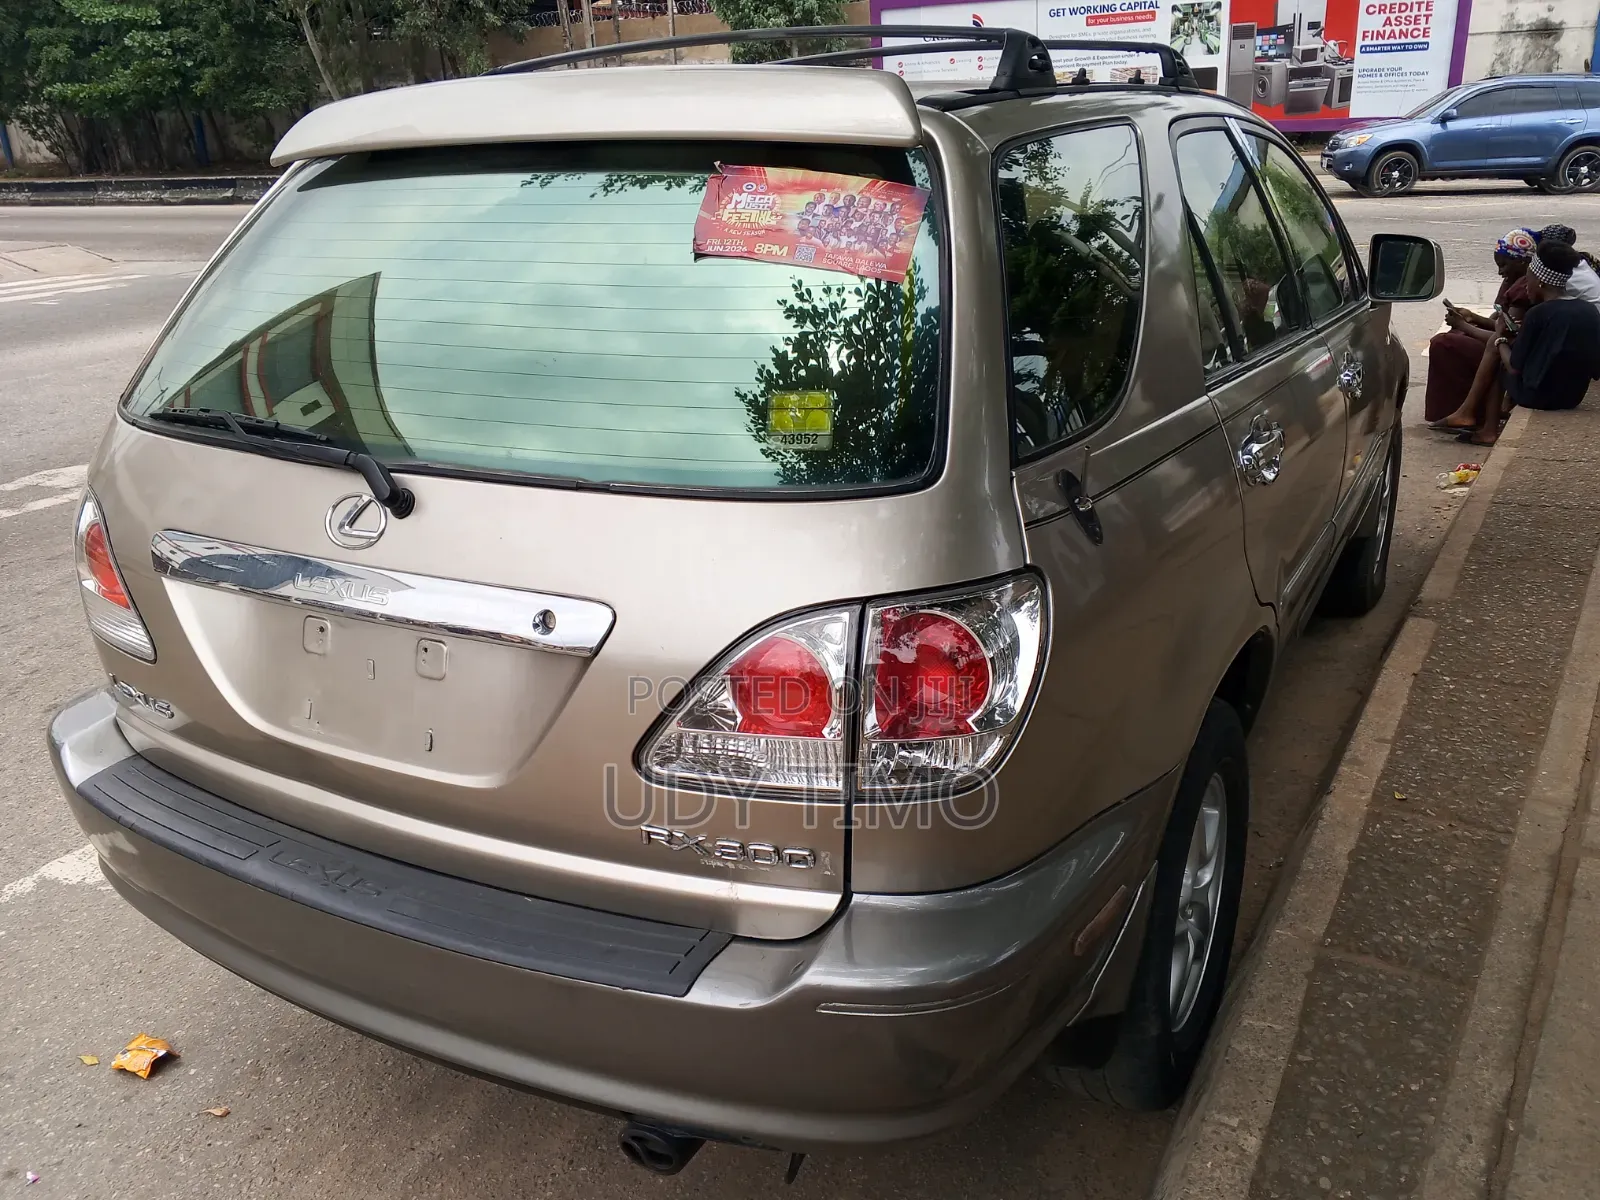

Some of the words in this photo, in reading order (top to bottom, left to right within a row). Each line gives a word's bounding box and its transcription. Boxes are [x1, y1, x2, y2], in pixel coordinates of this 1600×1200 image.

[1049, 8, 1067, 17] GET
[1069, 4, 1117, 16] WORKING
[1119, 0, 1160, 11] CAPITAL
[1365, 0, 1434, 15] CREDITE
[1382, 14, 1432, 28] ASSET
[1362, 27, 1431, 41] FINANCE
[721, 208, 777, 225] FESTIVAL
[722, 238, 744, 246] 12TH
[754, 243, 788, 257] 8PM
[824, 252, 854, 264] TAFAWA
[854, 258, 887, 269] BALEWA
[855, 264, 882, 274] LAGOS
[781, 433, 819, 445] 43952
[294, 572, 392, 606] LEXUS
[108, 672, 175, 719] LEXUS
[268, 850, 385, 898] LEXUS
